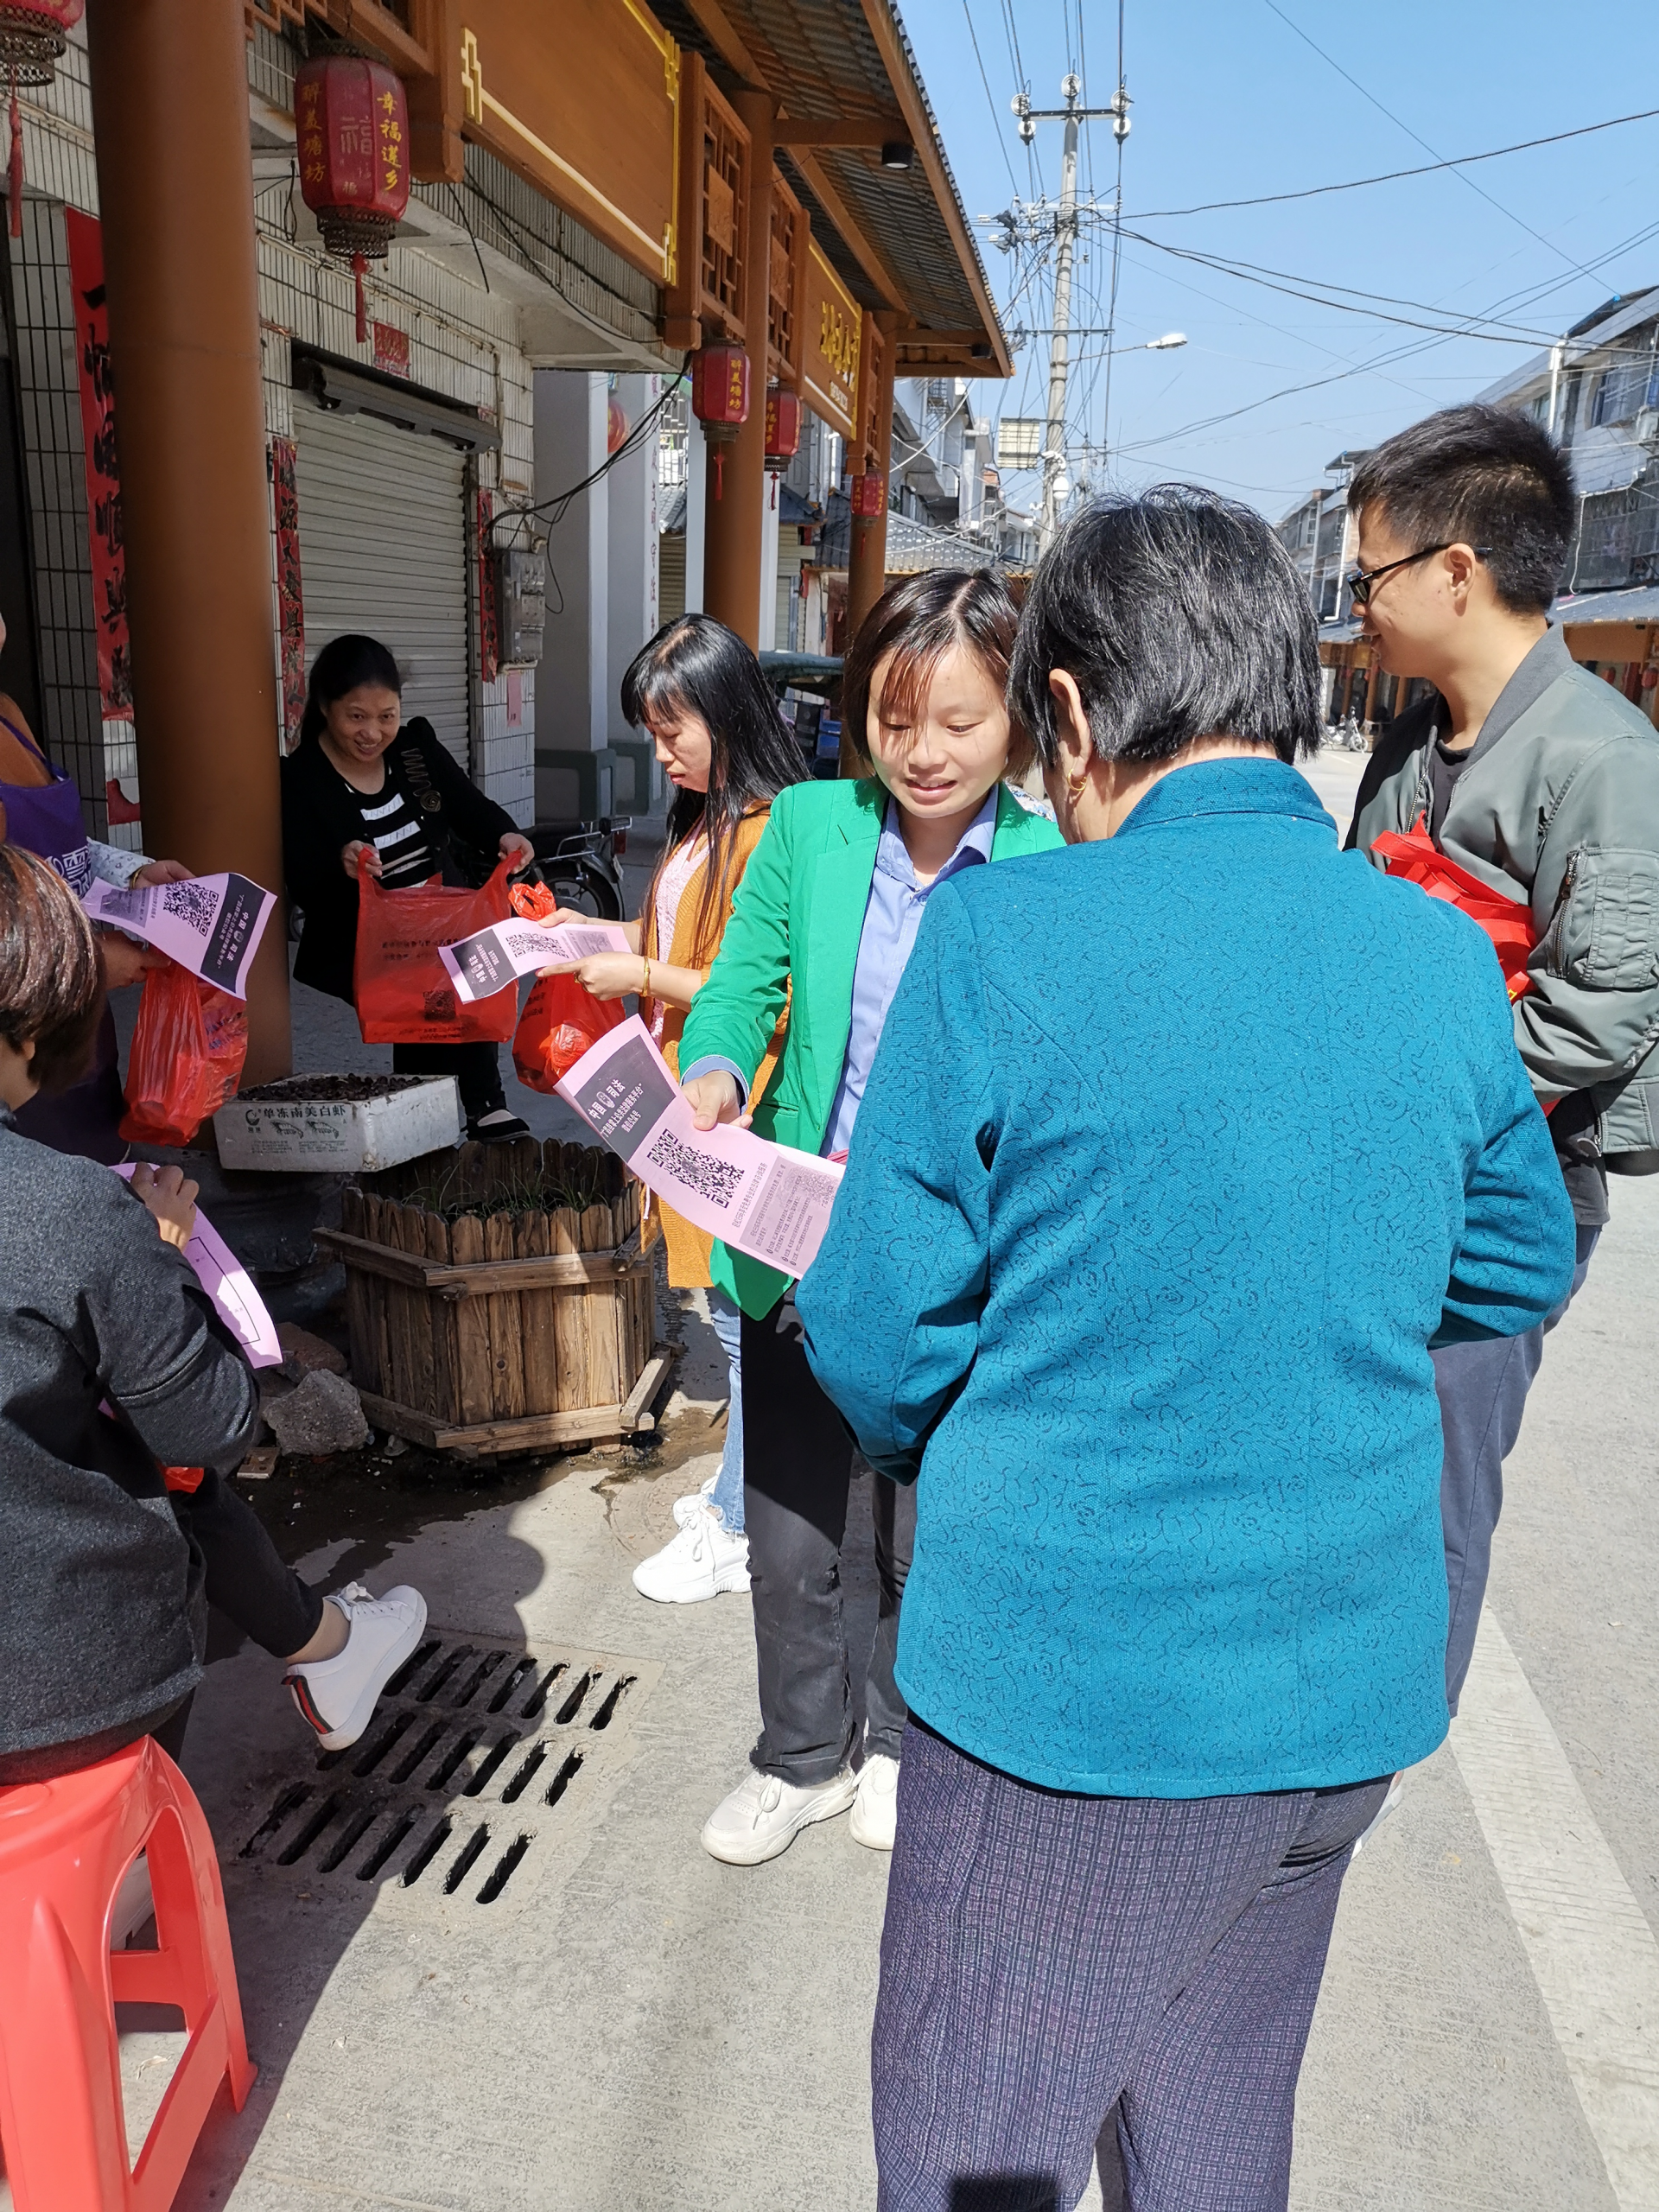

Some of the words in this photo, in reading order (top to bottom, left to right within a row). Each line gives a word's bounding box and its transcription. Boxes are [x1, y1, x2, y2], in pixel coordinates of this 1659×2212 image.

[238, 912, 249, 930] 中国
[588, 1101, 607, 1120] 中国
[606, 1079, 626, 1098] 司法
[264, 1105, 346, 1119] 单冻南美白虾
